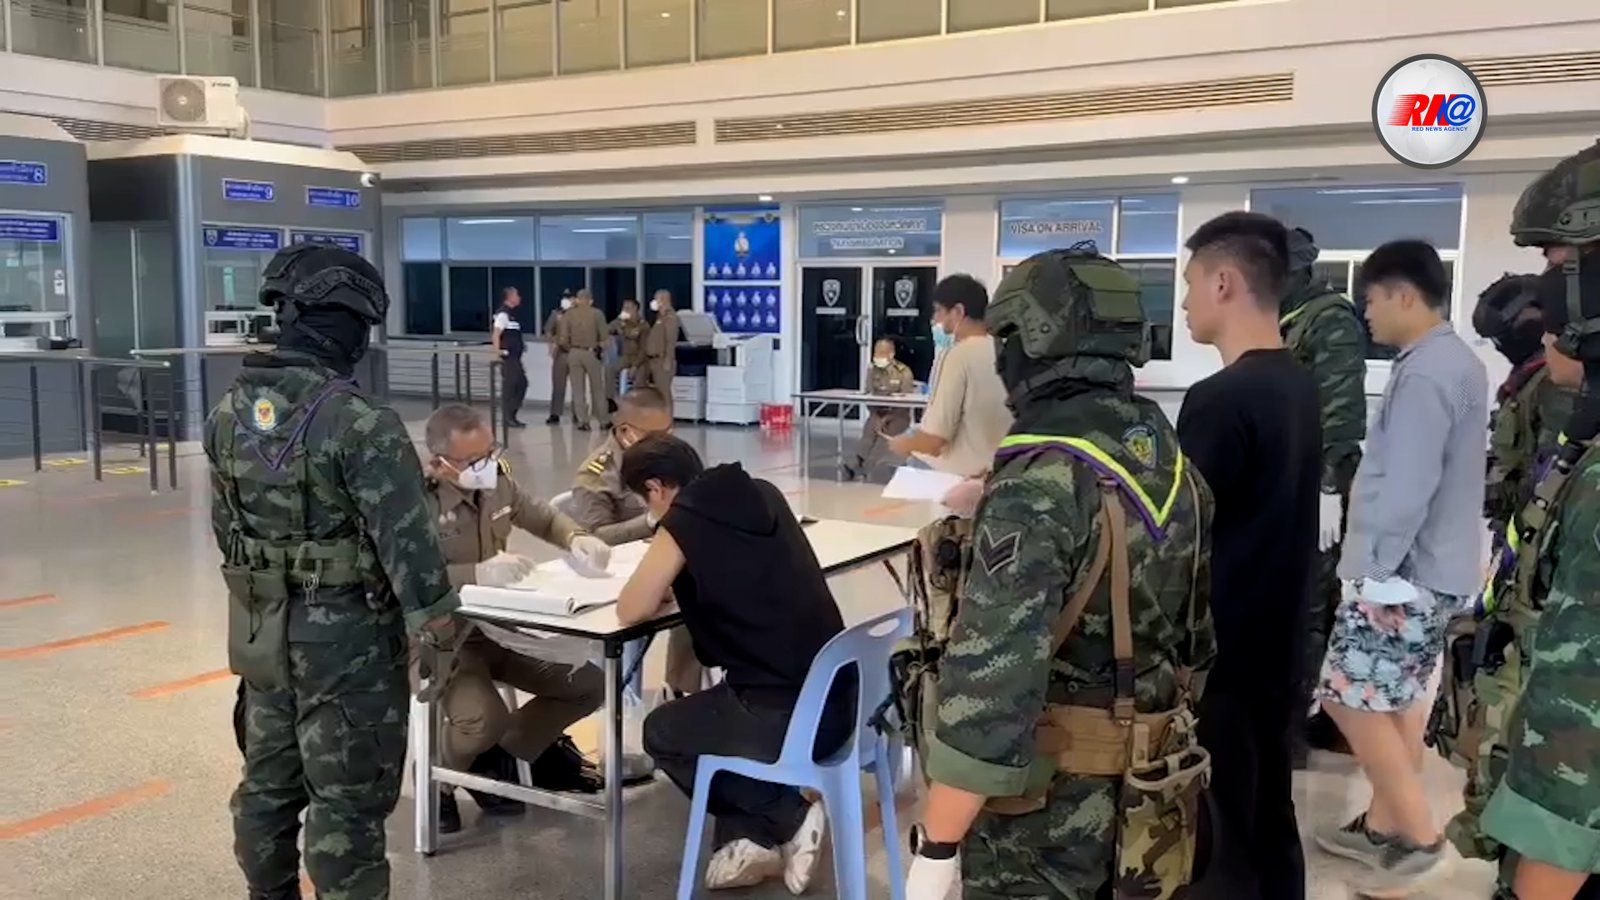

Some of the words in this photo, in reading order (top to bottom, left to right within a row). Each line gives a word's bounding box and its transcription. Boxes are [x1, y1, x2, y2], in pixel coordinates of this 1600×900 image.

[33, 167, 44, 182] 8
[264, 186, 273, 199] 9
[345, 194, 359, 206] 10
[1010, 222, 1035, 234] VISA
[1036, 222, 1053, 233] ON
[1056, 221, 1102, 233] ARRIVAL
